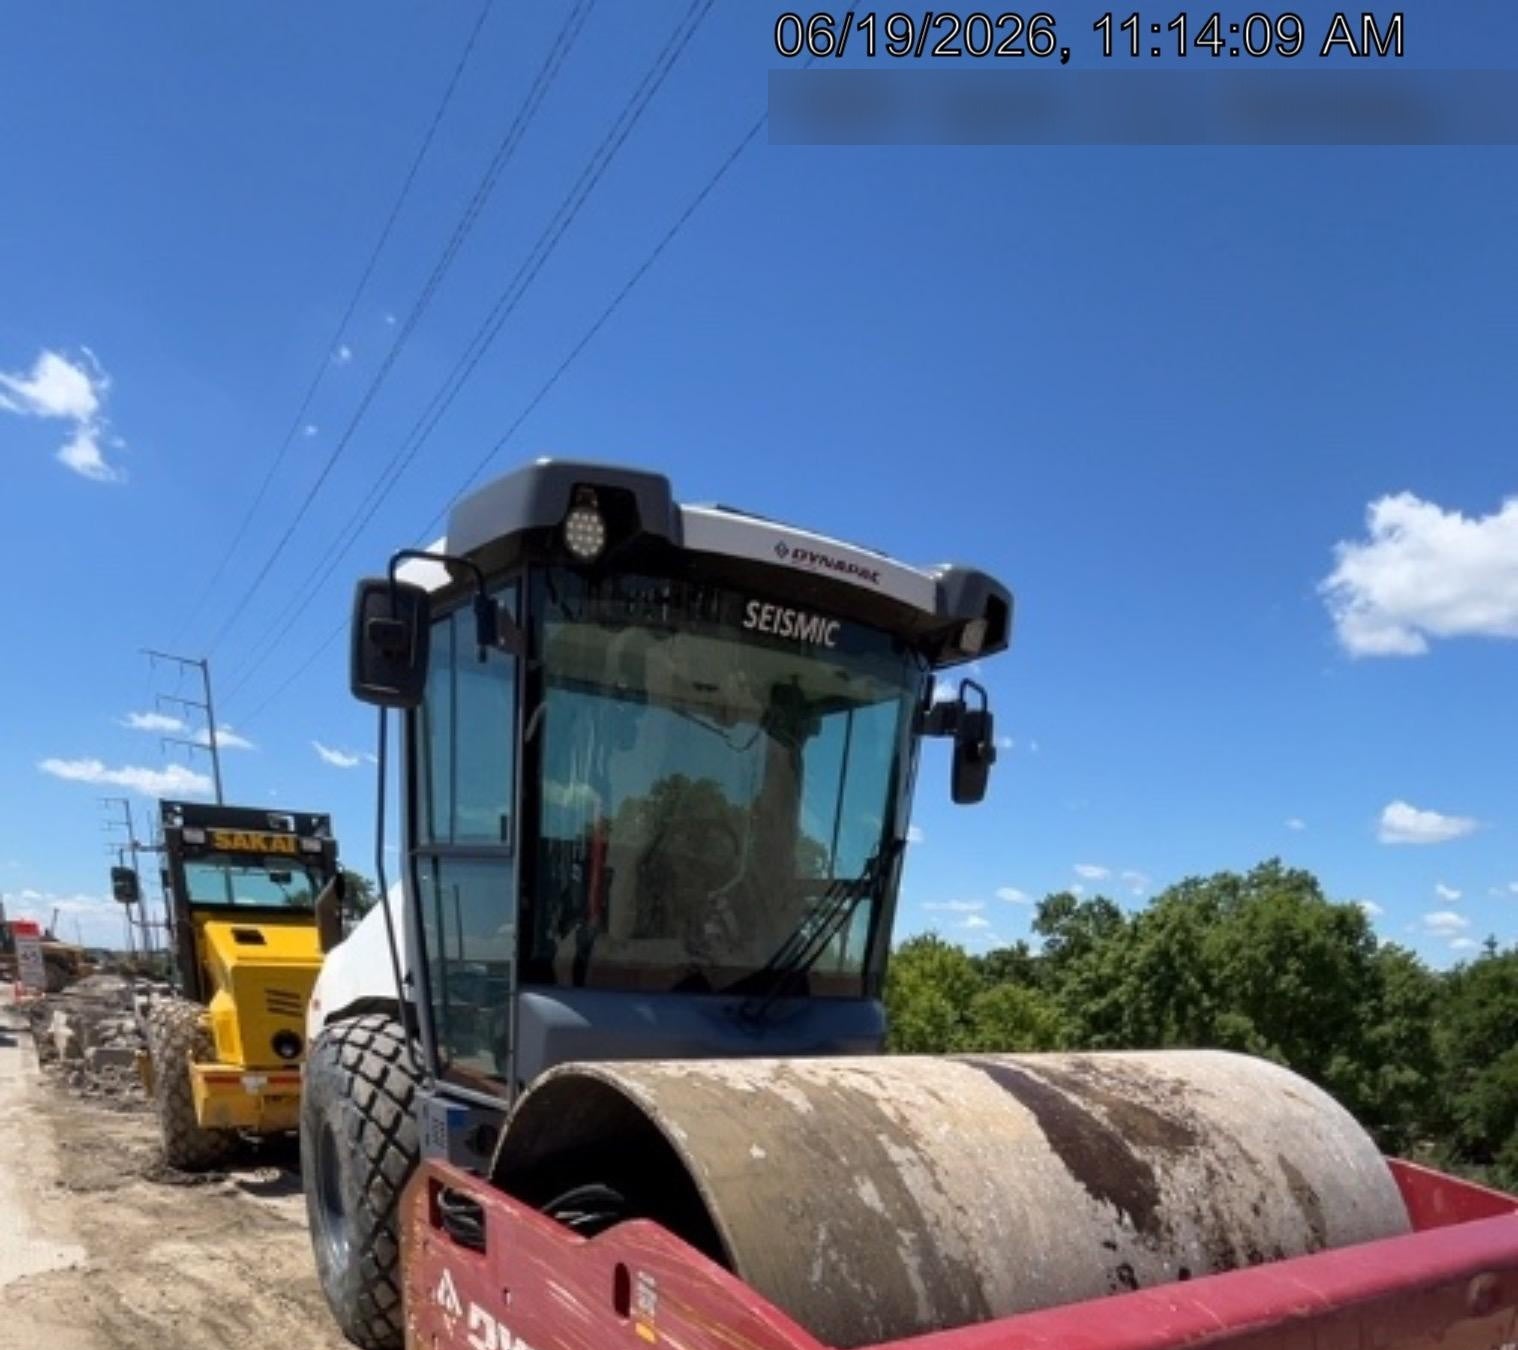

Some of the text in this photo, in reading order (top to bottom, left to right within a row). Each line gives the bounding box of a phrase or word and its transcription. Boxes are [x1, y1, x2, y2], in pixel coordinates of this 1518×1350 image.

[791, 547, 880, 584] DYNAPAC
[743, 601, 841, 648] SEISMIC
[213, 829, 296, 853] SAKAI
